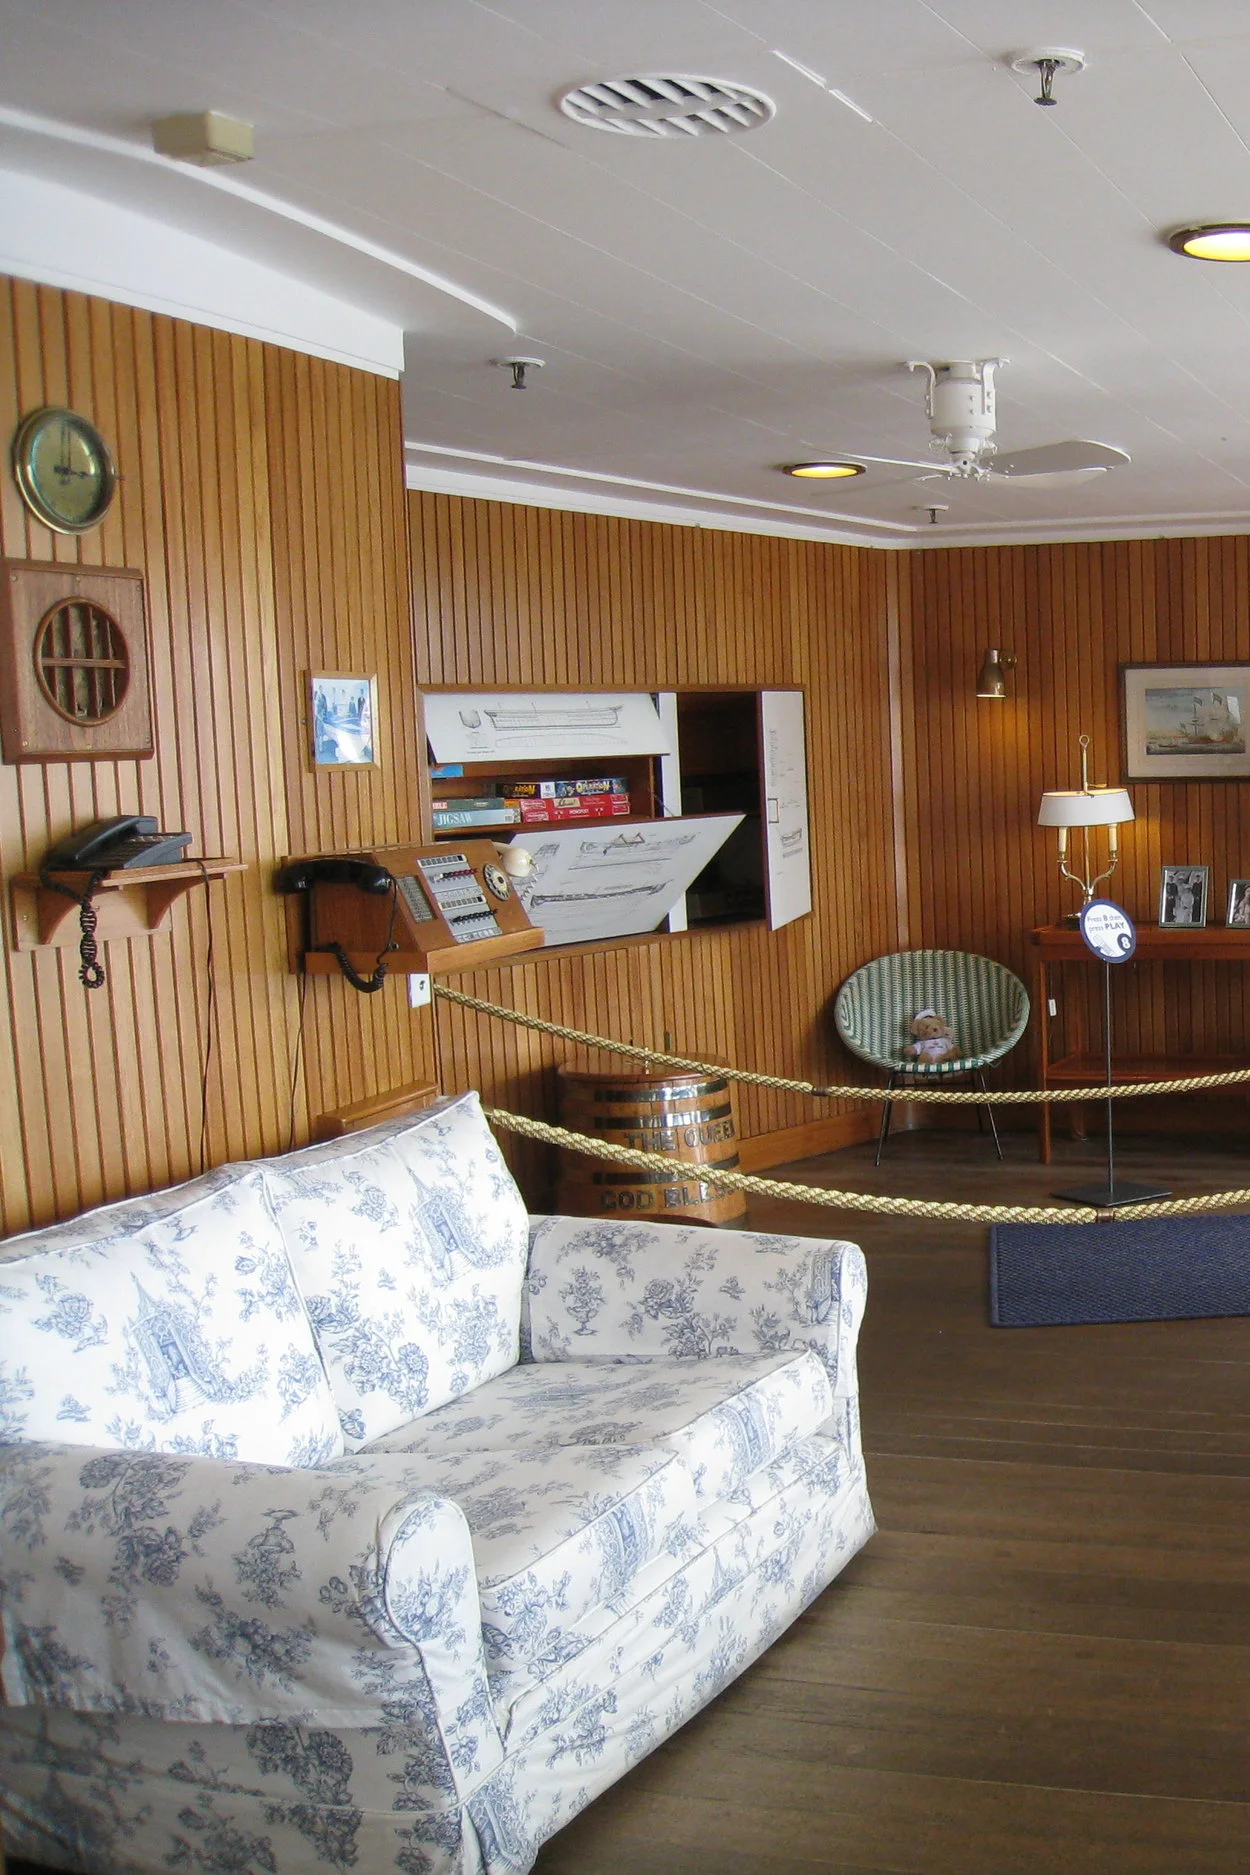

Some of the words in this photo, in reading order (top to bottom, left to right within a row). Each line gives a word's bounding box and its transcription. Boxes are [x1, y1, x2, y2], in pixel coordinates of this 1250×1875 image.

[437, 812, 473, 826] JIGSAW
[1105, 922, 1125, 930] PLAY
[1121, 936, 1131, 950] 8
[624, 1129, 678, 1151] THE
[602, 1190, 654, 1210] GOD
